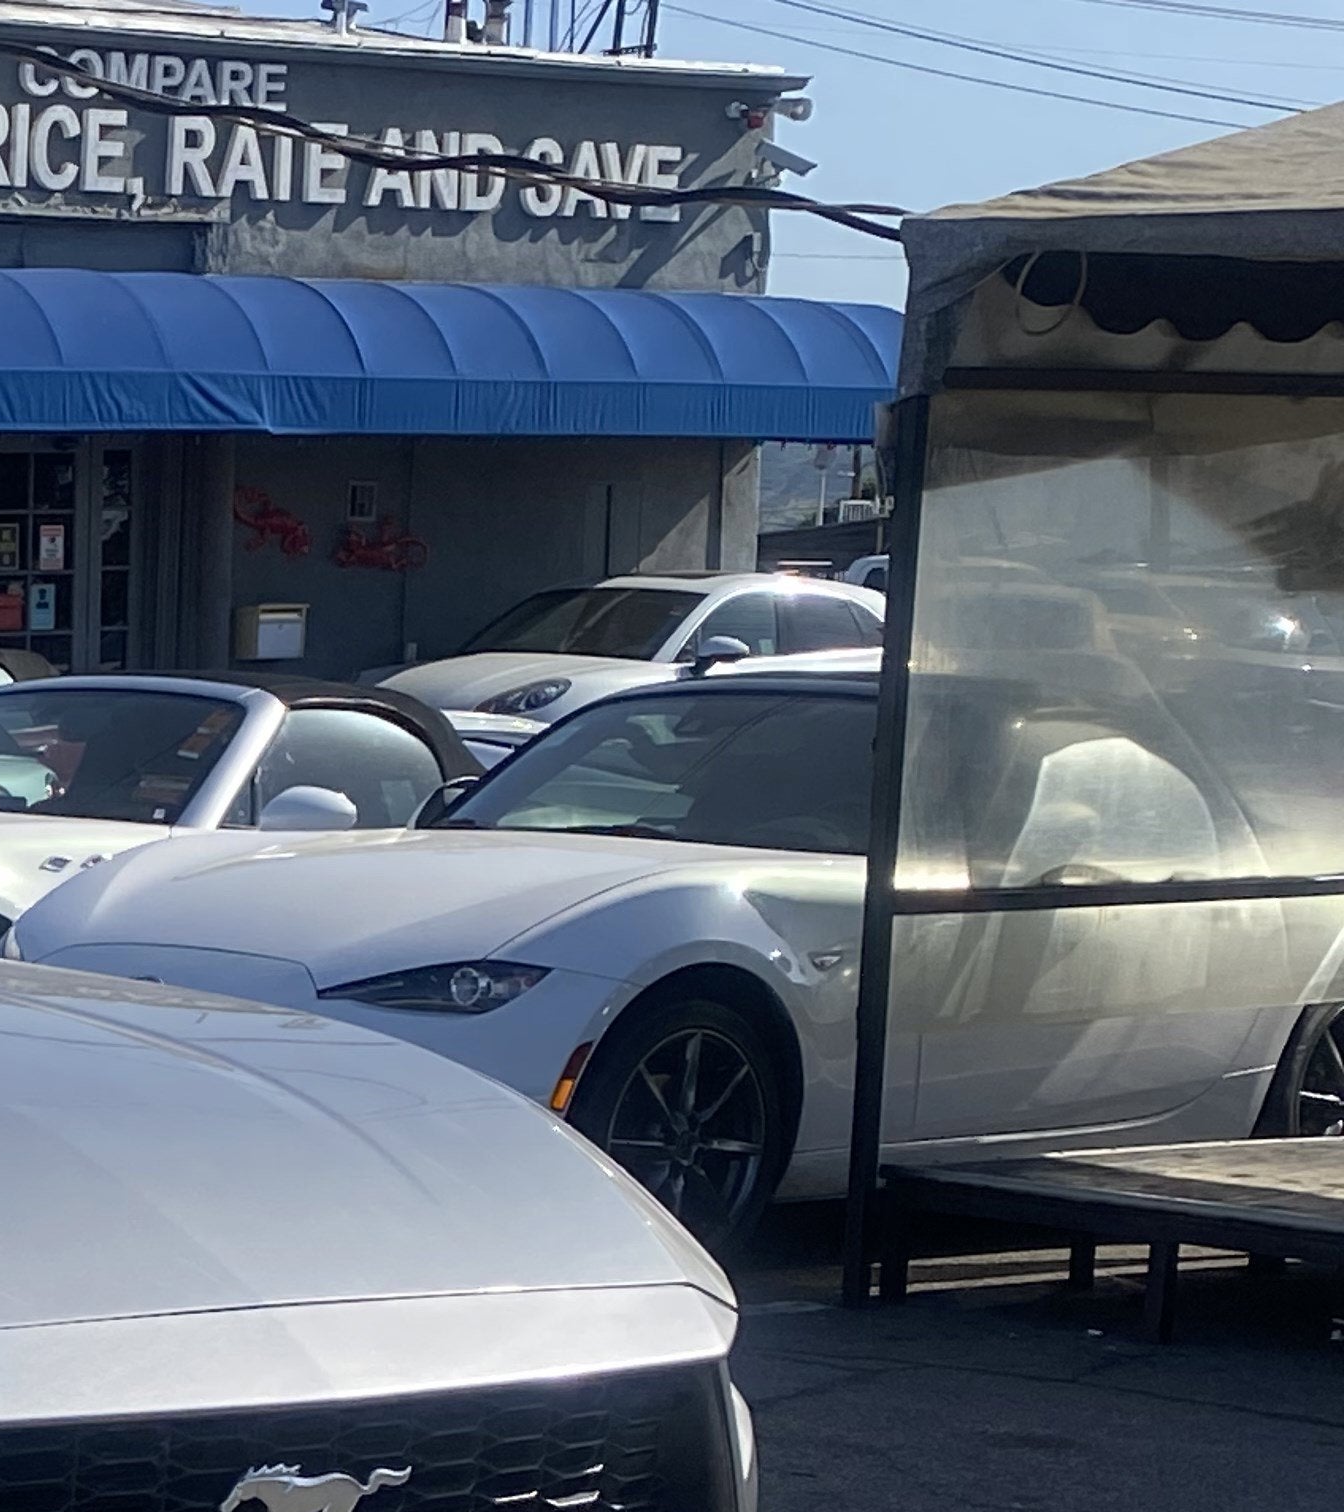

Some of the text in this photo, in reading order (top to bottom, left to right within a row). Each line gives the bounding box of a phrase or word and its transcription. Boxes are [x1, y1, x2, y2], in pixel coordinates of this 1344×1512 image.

[19, 46, 288, 112] COMPARE
[168, 116, 348, 204] RATE
[364, 126, 507, 213] AND
[522, 136, 682, 223] SAVE
